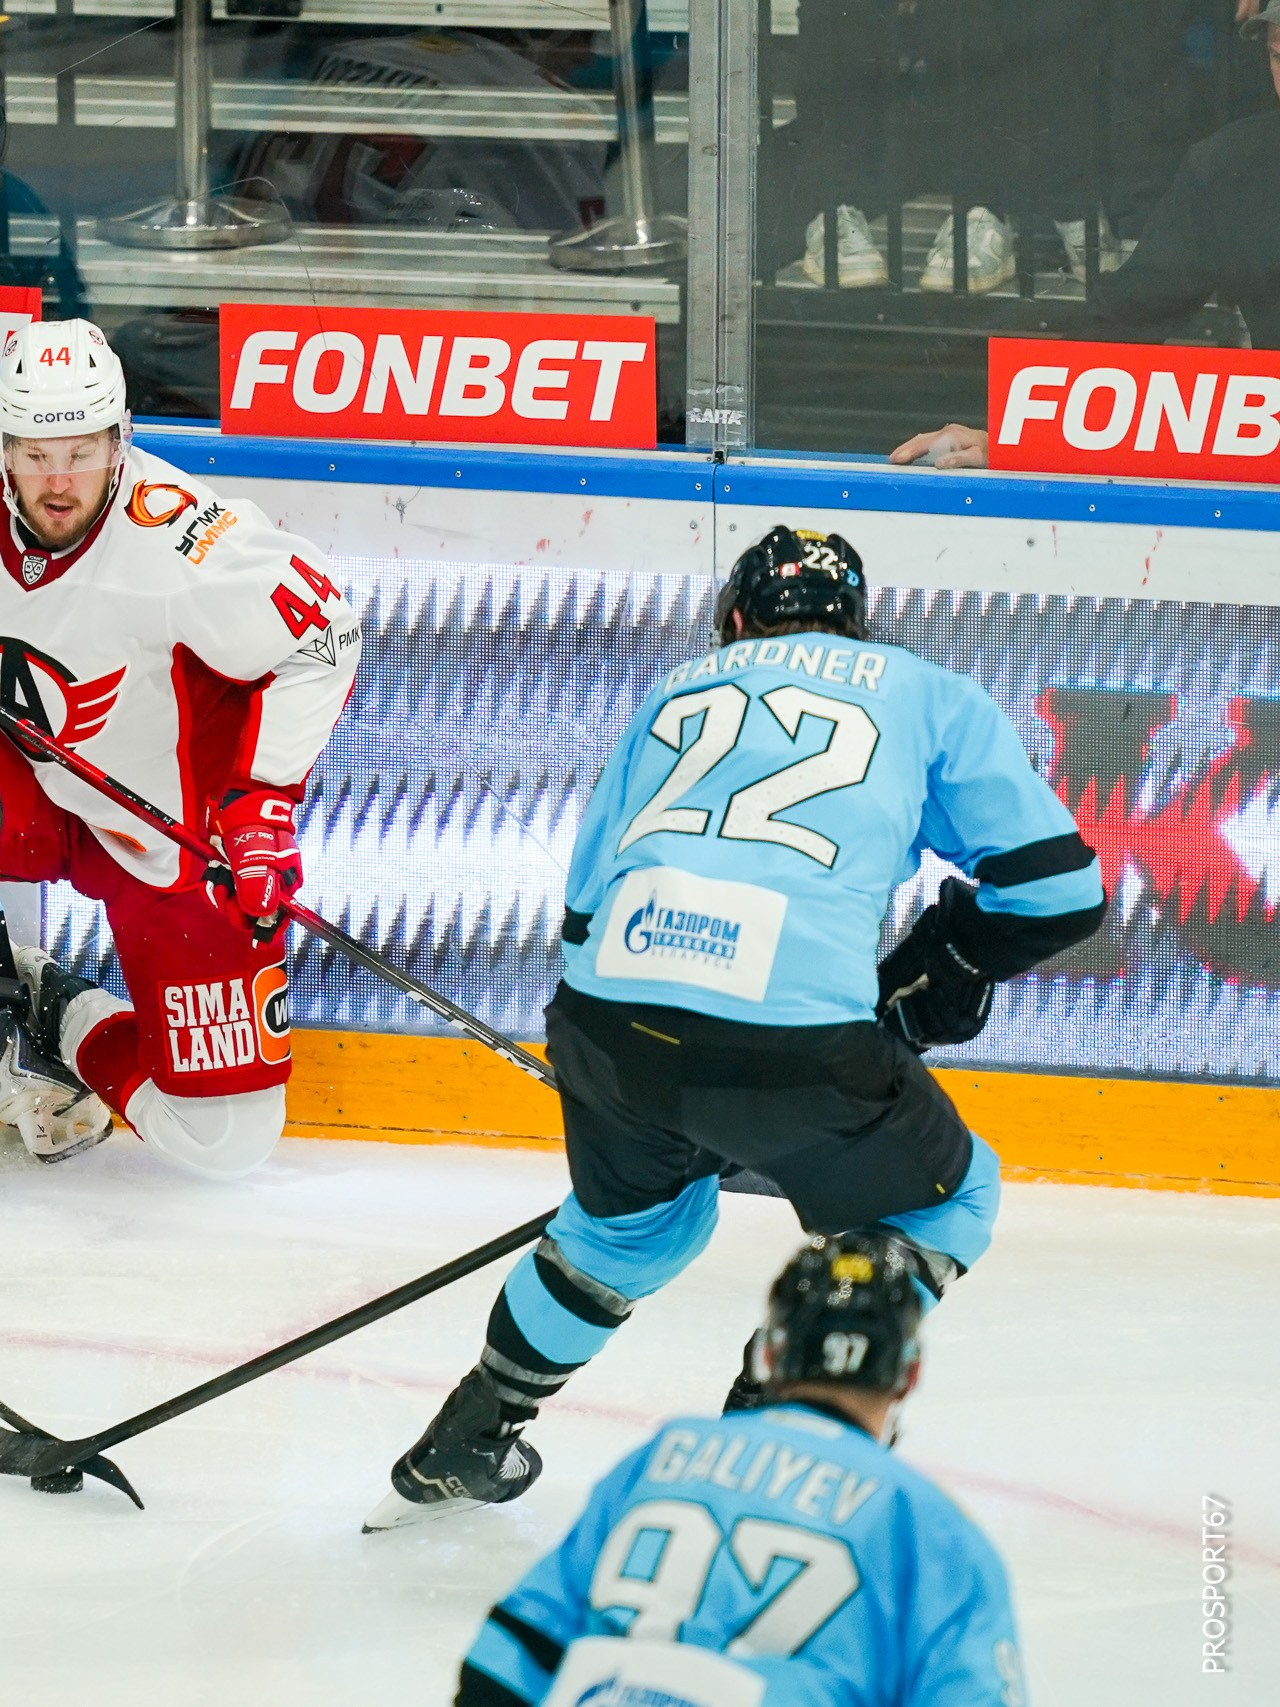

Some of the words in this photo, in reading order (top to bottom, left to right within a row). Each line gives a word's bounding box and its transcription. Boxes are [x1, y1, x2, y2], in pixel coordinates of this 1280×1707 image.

[39, 347, 72, 367] 44
[229, 330, 646, 423] FONBET
[33, 410, 86, 424] согаз
[997, 365, 1280, 458] FONB
[174, 501, 227, 557] УГМК
[187, 511, 238, 565] UMMC
[803, 545, 838, 573] 22
[270, 554, 341, 640] 44
[338, 624, 361, 650] РМК
[664, 637, 887, 695] GARDNER
[616, 682, 880, 870] 22
[233, 831, 258, 847] XF
[257, 831, 275, 841] PRO
[261, 874, 274, 908] CCM
[656, 907, 741, 943] ГАЗПРОМ
[164, 978, 251, 1028] SIMA
[168, 1019, 255, 1073] LAND
[822, 1331, 870, 1377] 97
[646, 1427, 886, 1528] GALIYEV
[588, 1500, 861, 1660] 97
